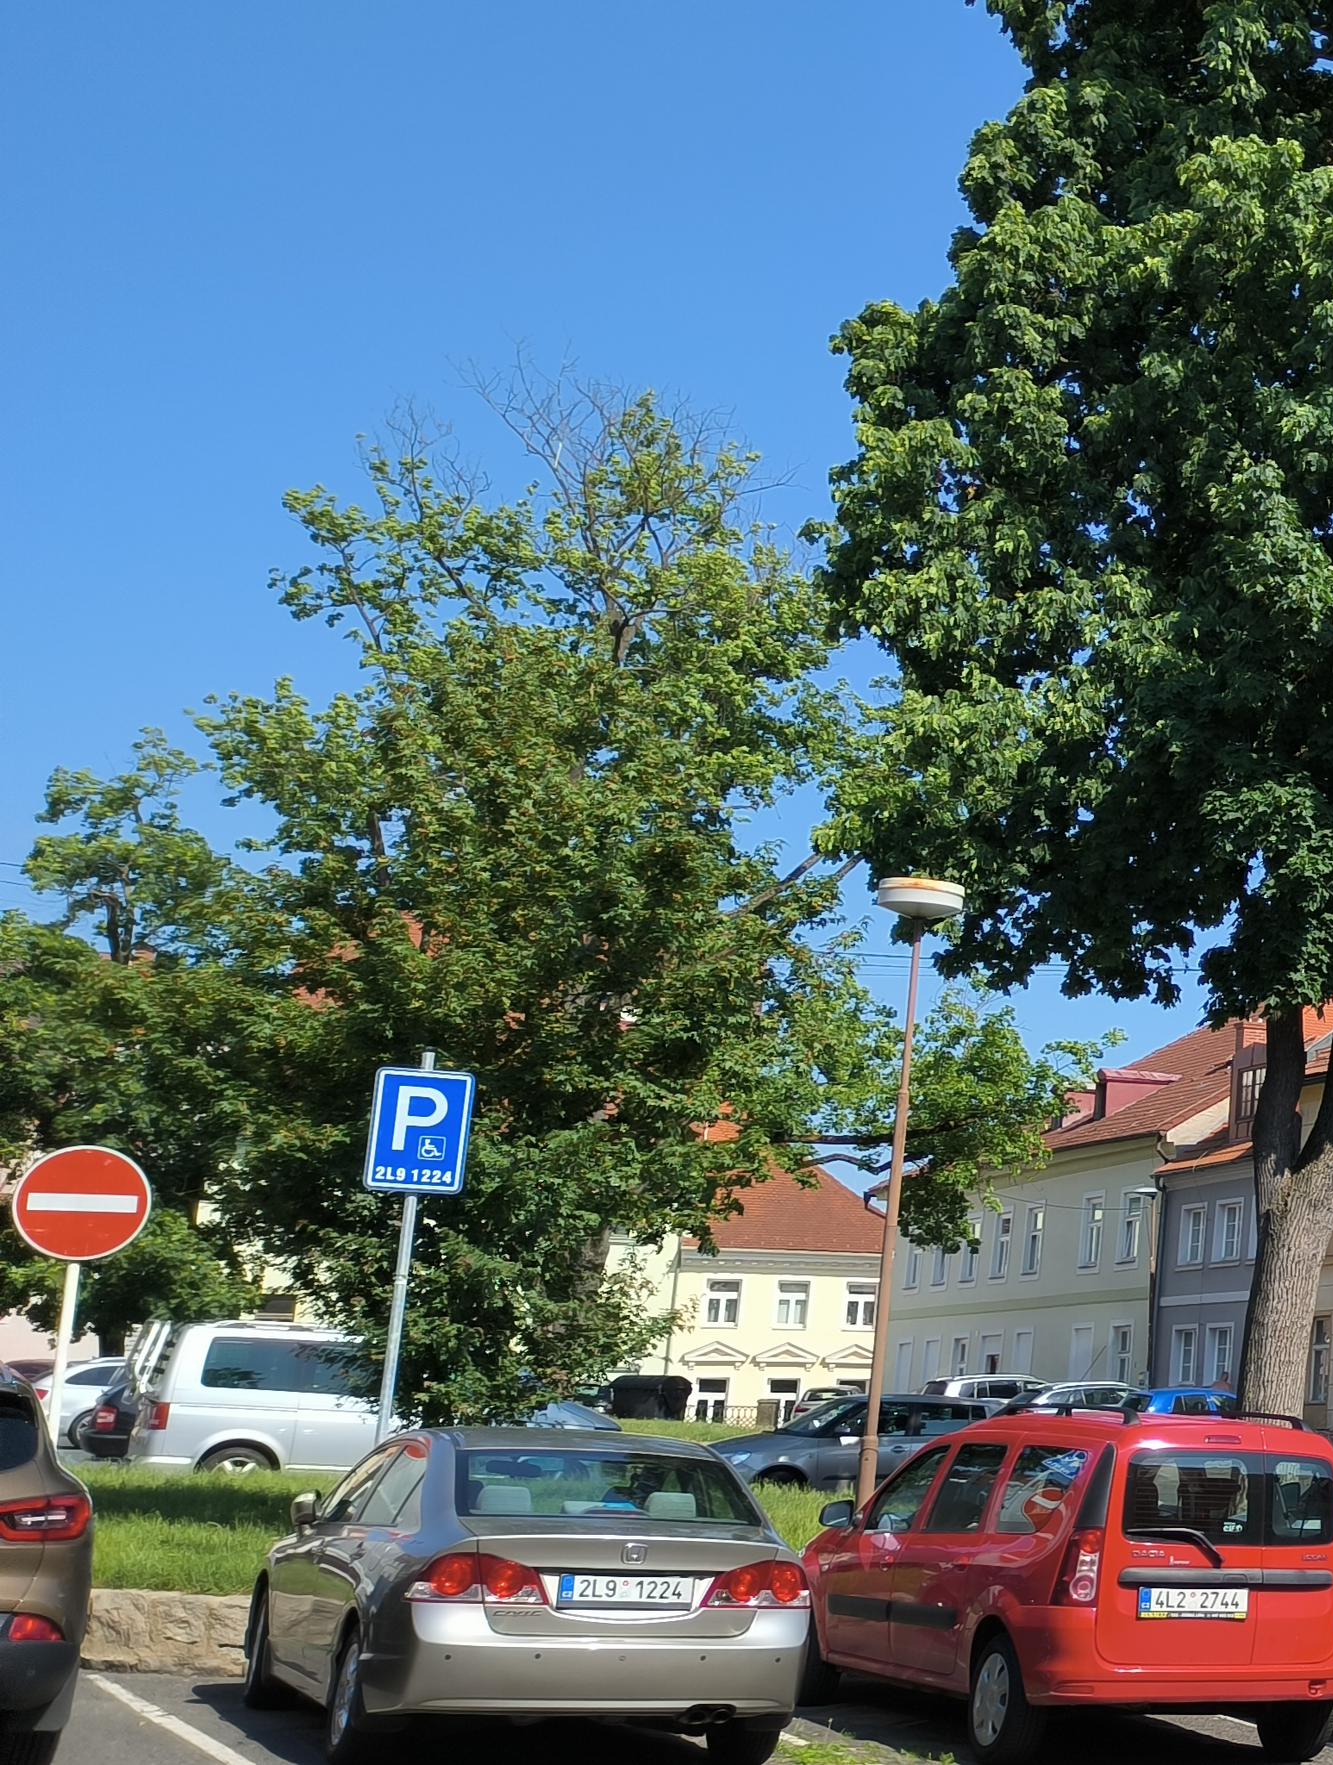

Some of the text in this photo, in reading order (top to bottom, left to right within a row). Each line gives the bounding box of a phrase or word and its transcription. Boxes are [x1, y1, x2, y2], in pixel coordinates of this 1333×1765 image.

[391, 1085, 449, 1151] P
[374, 1165, 453, 1184] 2L9 1224
[578, 1578, 617, 1599] 2L9
[635, 1580, 683, 1600] 1224
[1155, 1590, 1240, 1610] 4L2 2744
